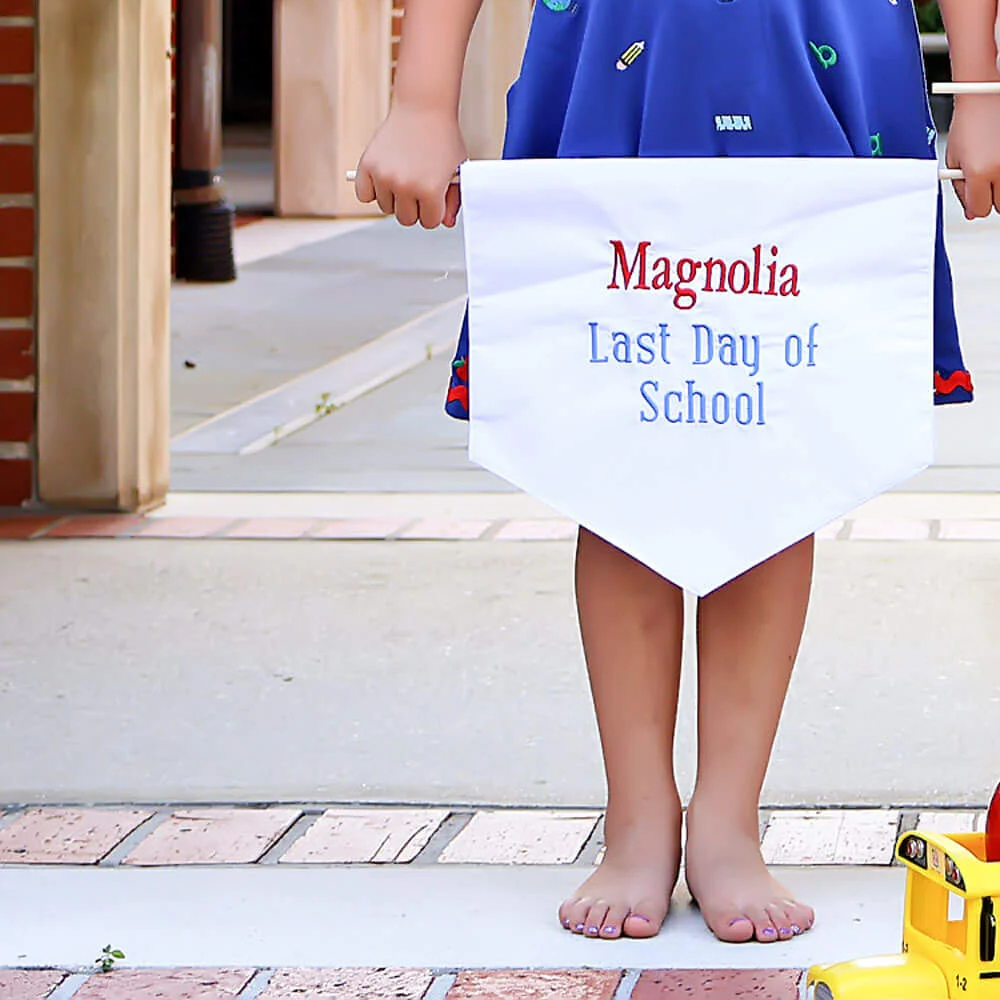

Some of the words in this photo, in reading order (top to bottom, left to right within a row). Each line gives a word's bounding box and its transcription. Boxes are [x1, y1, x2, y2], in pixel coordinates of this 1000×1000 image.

[606, 239, 801, 310] Magnolia
[588, 322, 672, 365] Last
[692, 323, 761, 377] Day
[784, 322, 819, 367] of
[639, 379, 766, 425] School
